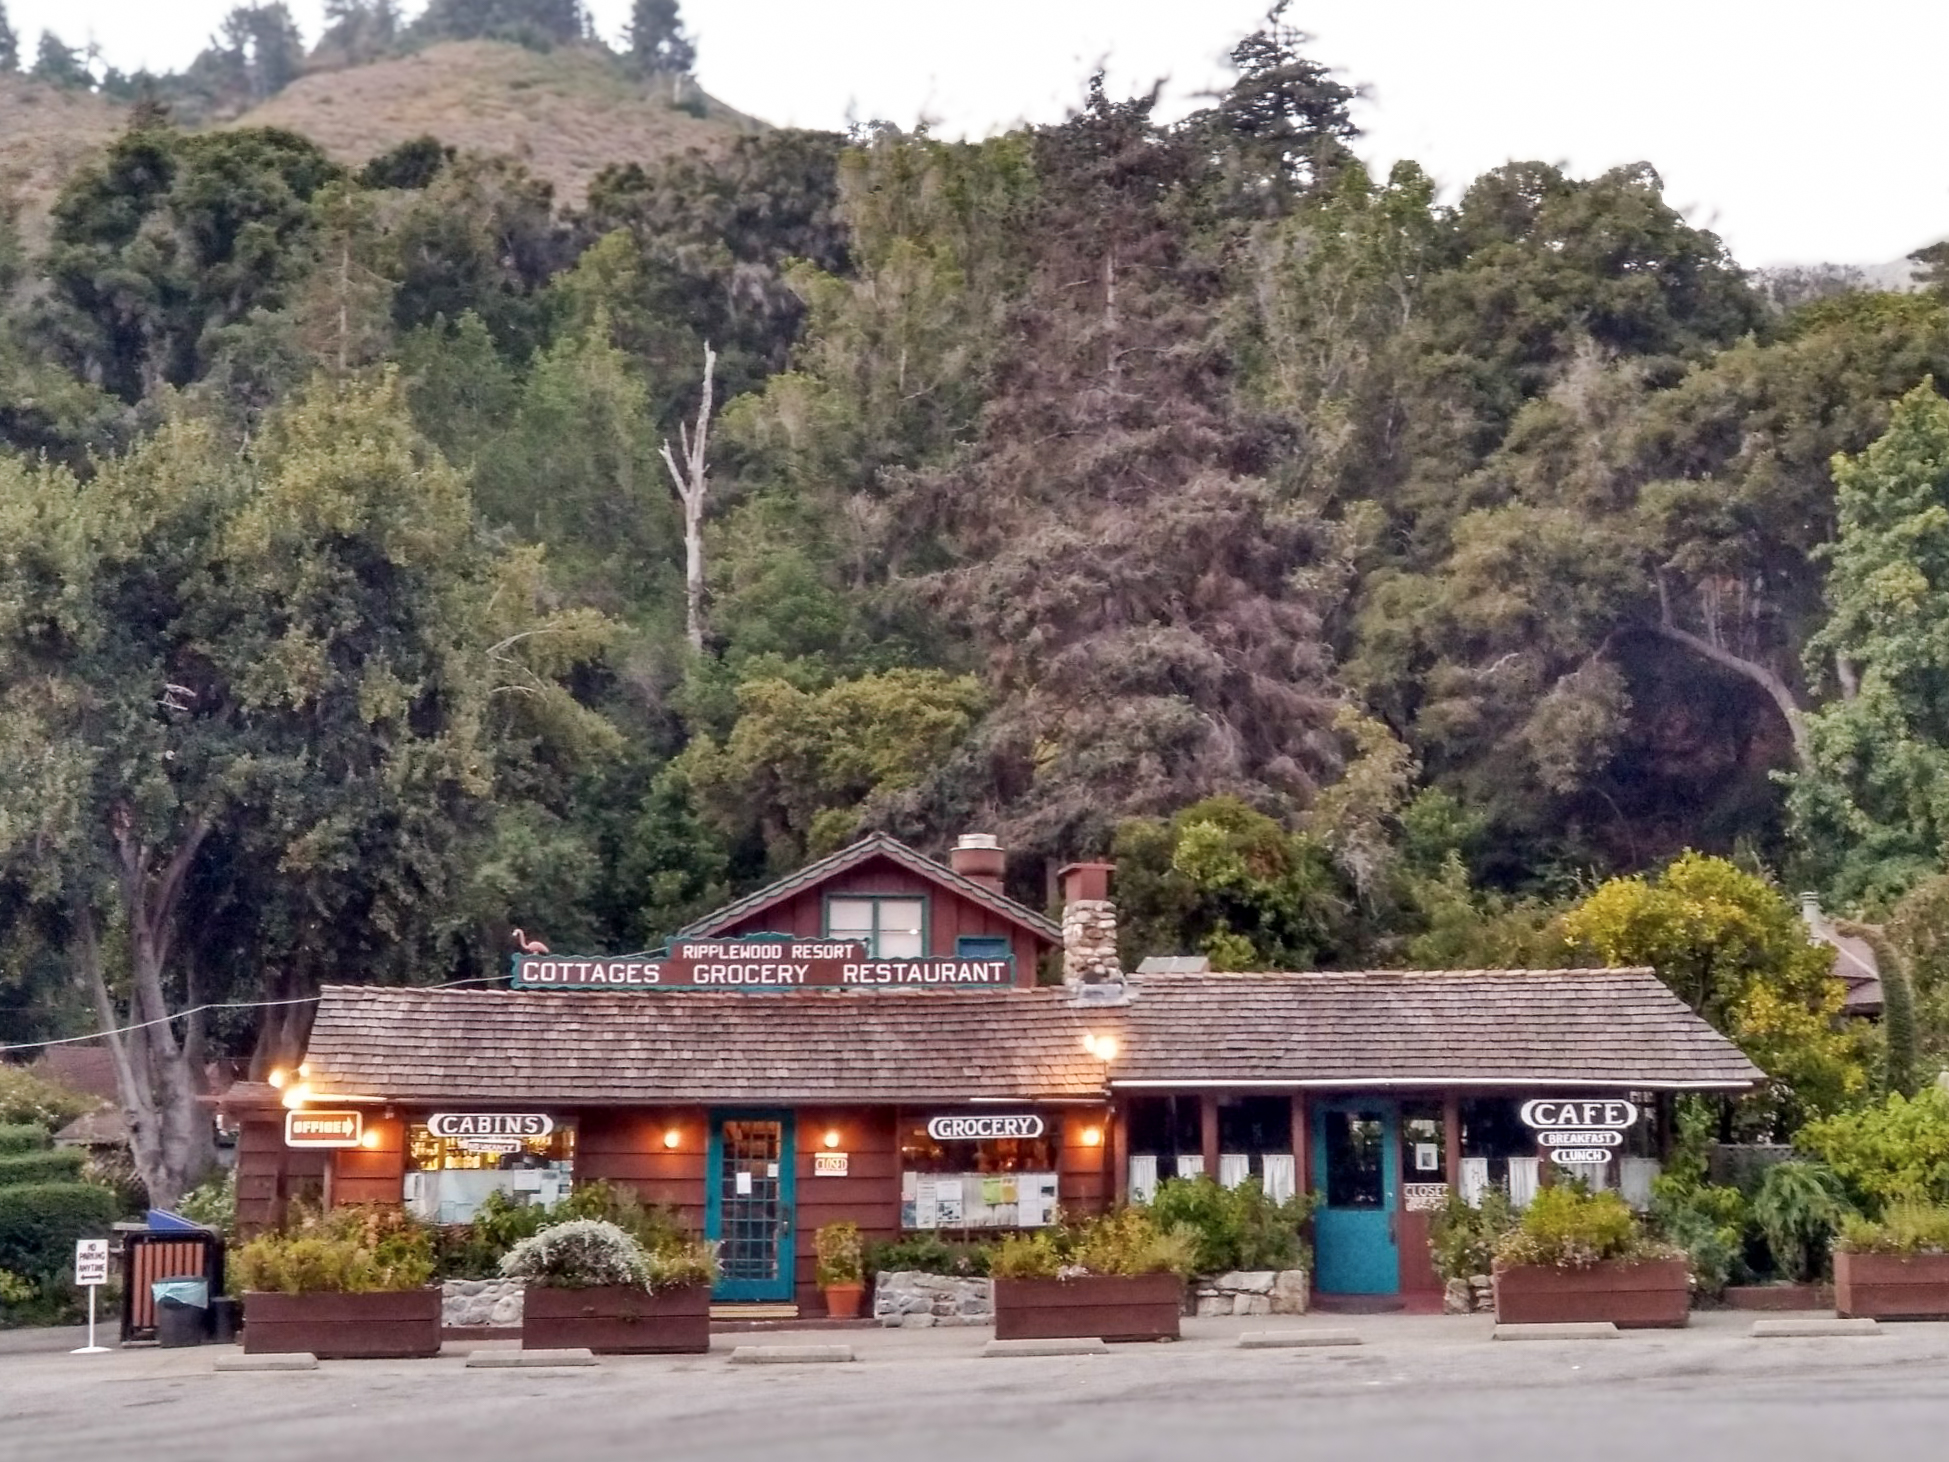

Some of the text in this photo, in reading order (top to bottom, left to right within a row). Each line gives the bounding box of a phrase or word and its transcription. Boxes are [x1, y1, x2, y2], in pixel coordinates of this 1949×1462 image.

[683, 944, 855, 960] RIPPLEWOOD RESORT
[522, 961, 1006, 985] COTTAGES GROCERY RESTAURANT
[1535, 1103, 1625, 1126] CAFE
[293, 1121, 342, 1134] OFFICE
[442, 1115, 541, 1135] CABINS
[937, 1118, 1034, 1137] GROCERY
[1548, 1133, 1612, 1146] BREAKFAST
[1561, 1150, 1602, 1162] LUNCH
[814, 1158, 848, 1171] CLOSED
[87, 1243, 97, 1251] NO
[79, 1252, 106, 1261] PARKING
[78, 1263, 106, 1273] ANYTIME
